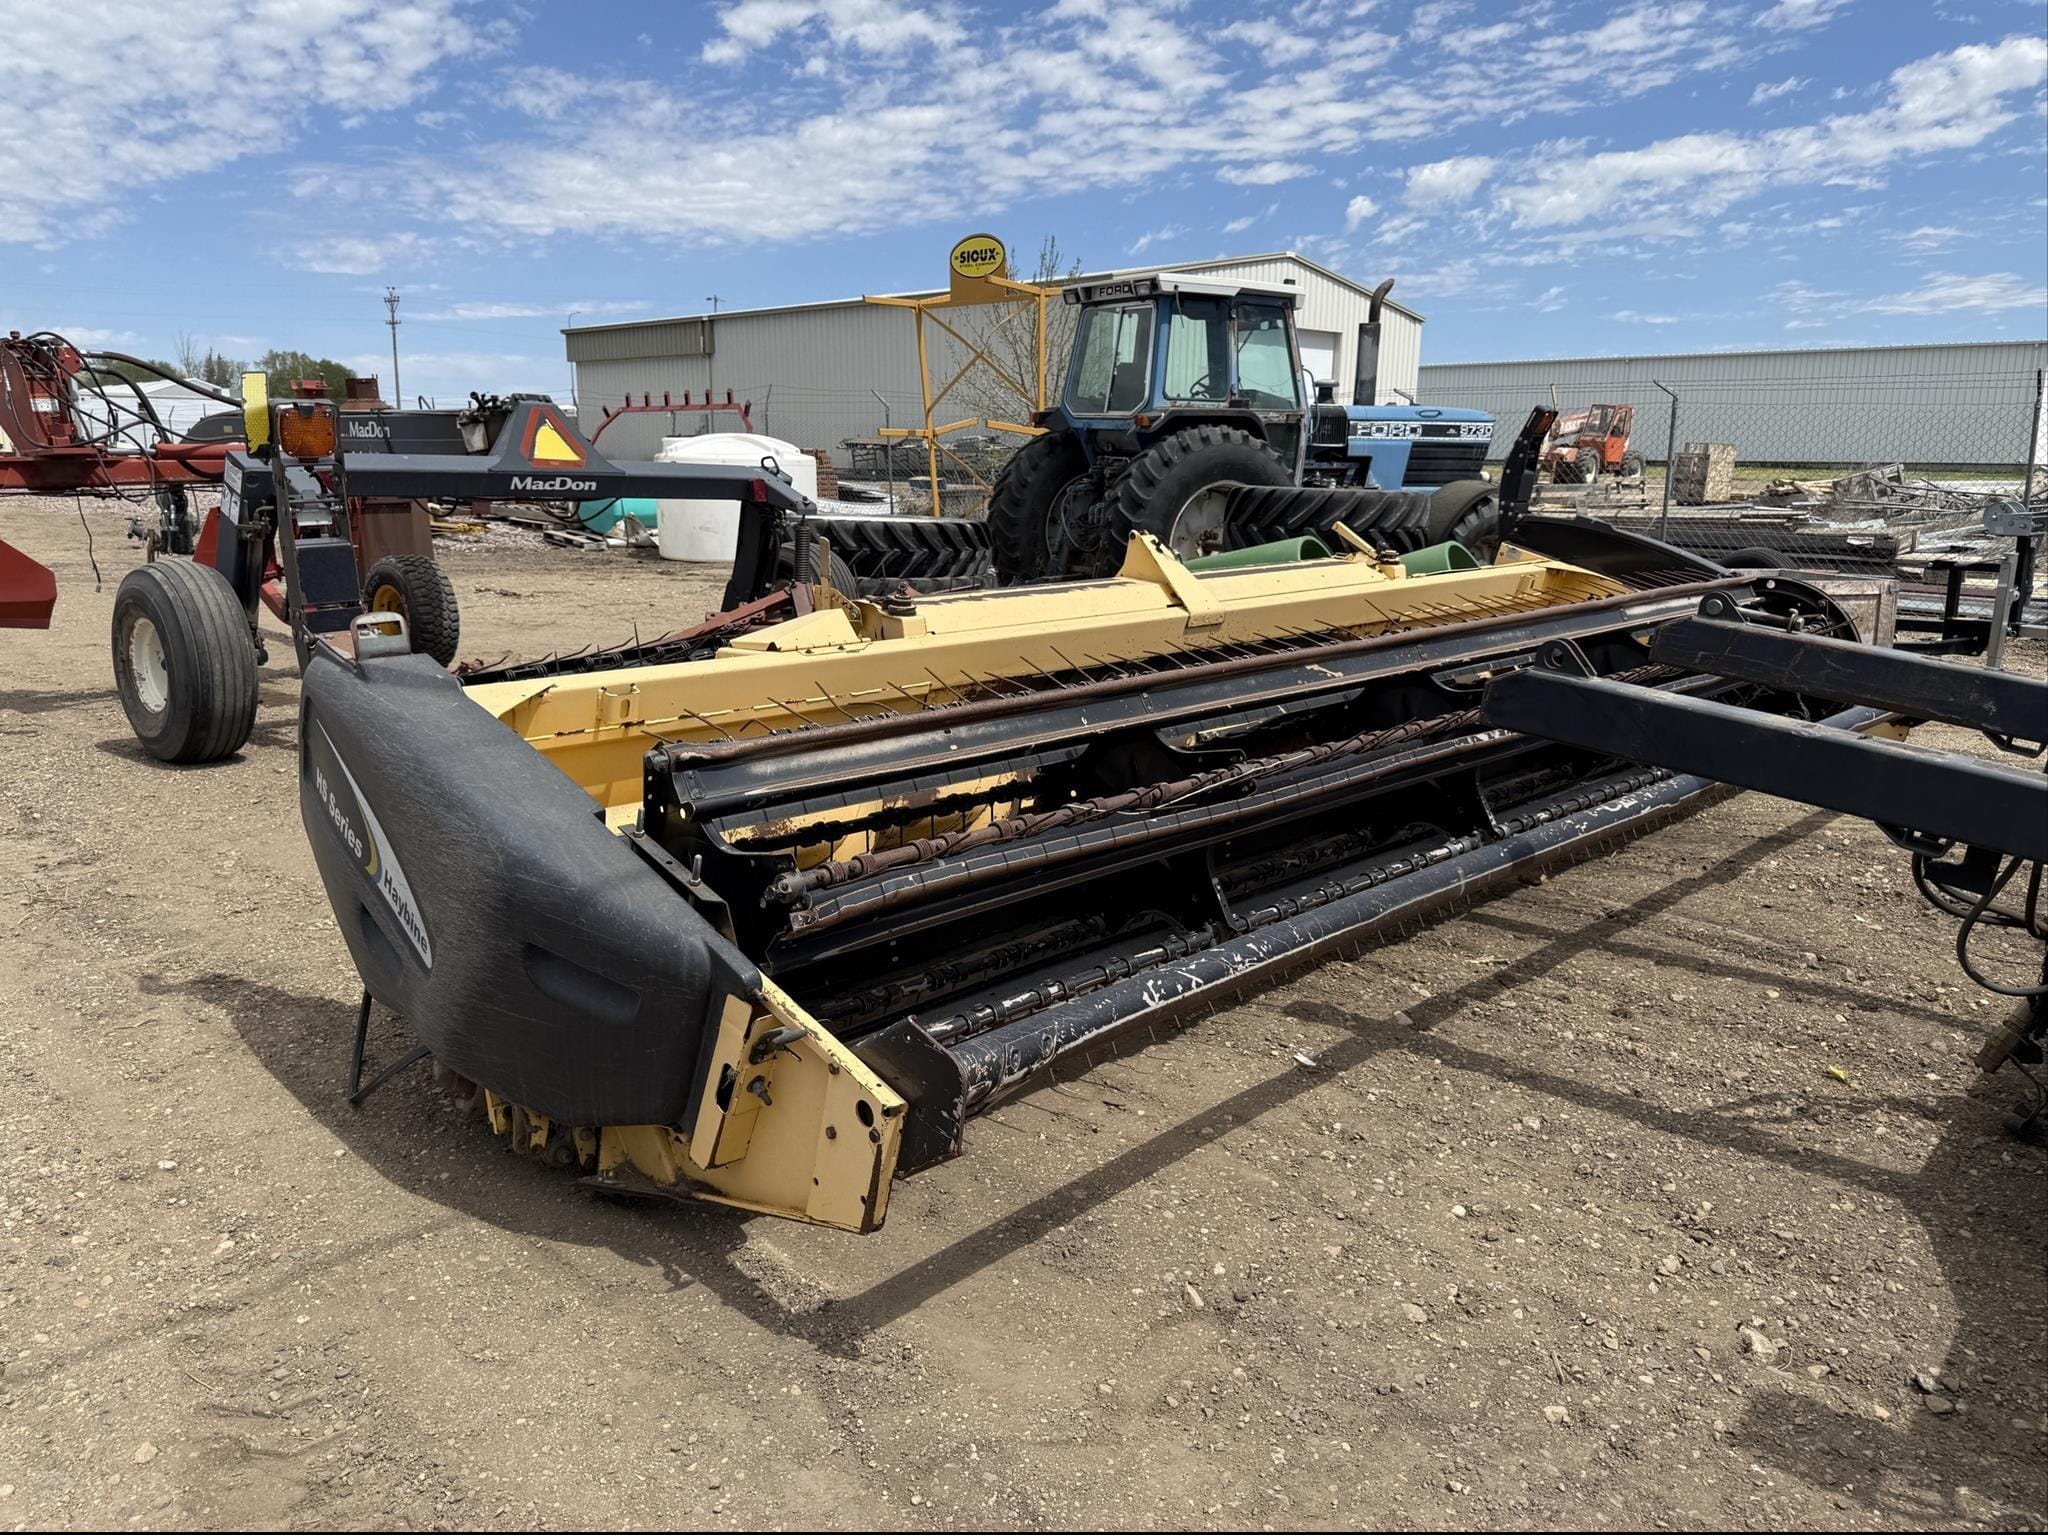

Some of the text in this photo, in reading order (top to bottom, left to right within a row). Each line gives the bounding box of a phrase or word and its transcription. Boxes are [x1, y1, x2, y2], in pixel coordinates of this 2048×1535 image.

[959, 247, 997, 264] SIOUX
[1100, 283, 1133, 297] FORD
[349, 421, 391, 438] MacDon
[1357, 423, 1422, 437] FORD
[510, 476, 597, 491] MacDon
[316, 767, 363, 858] HS Series
[384, 869, 428, 954] Haybine
